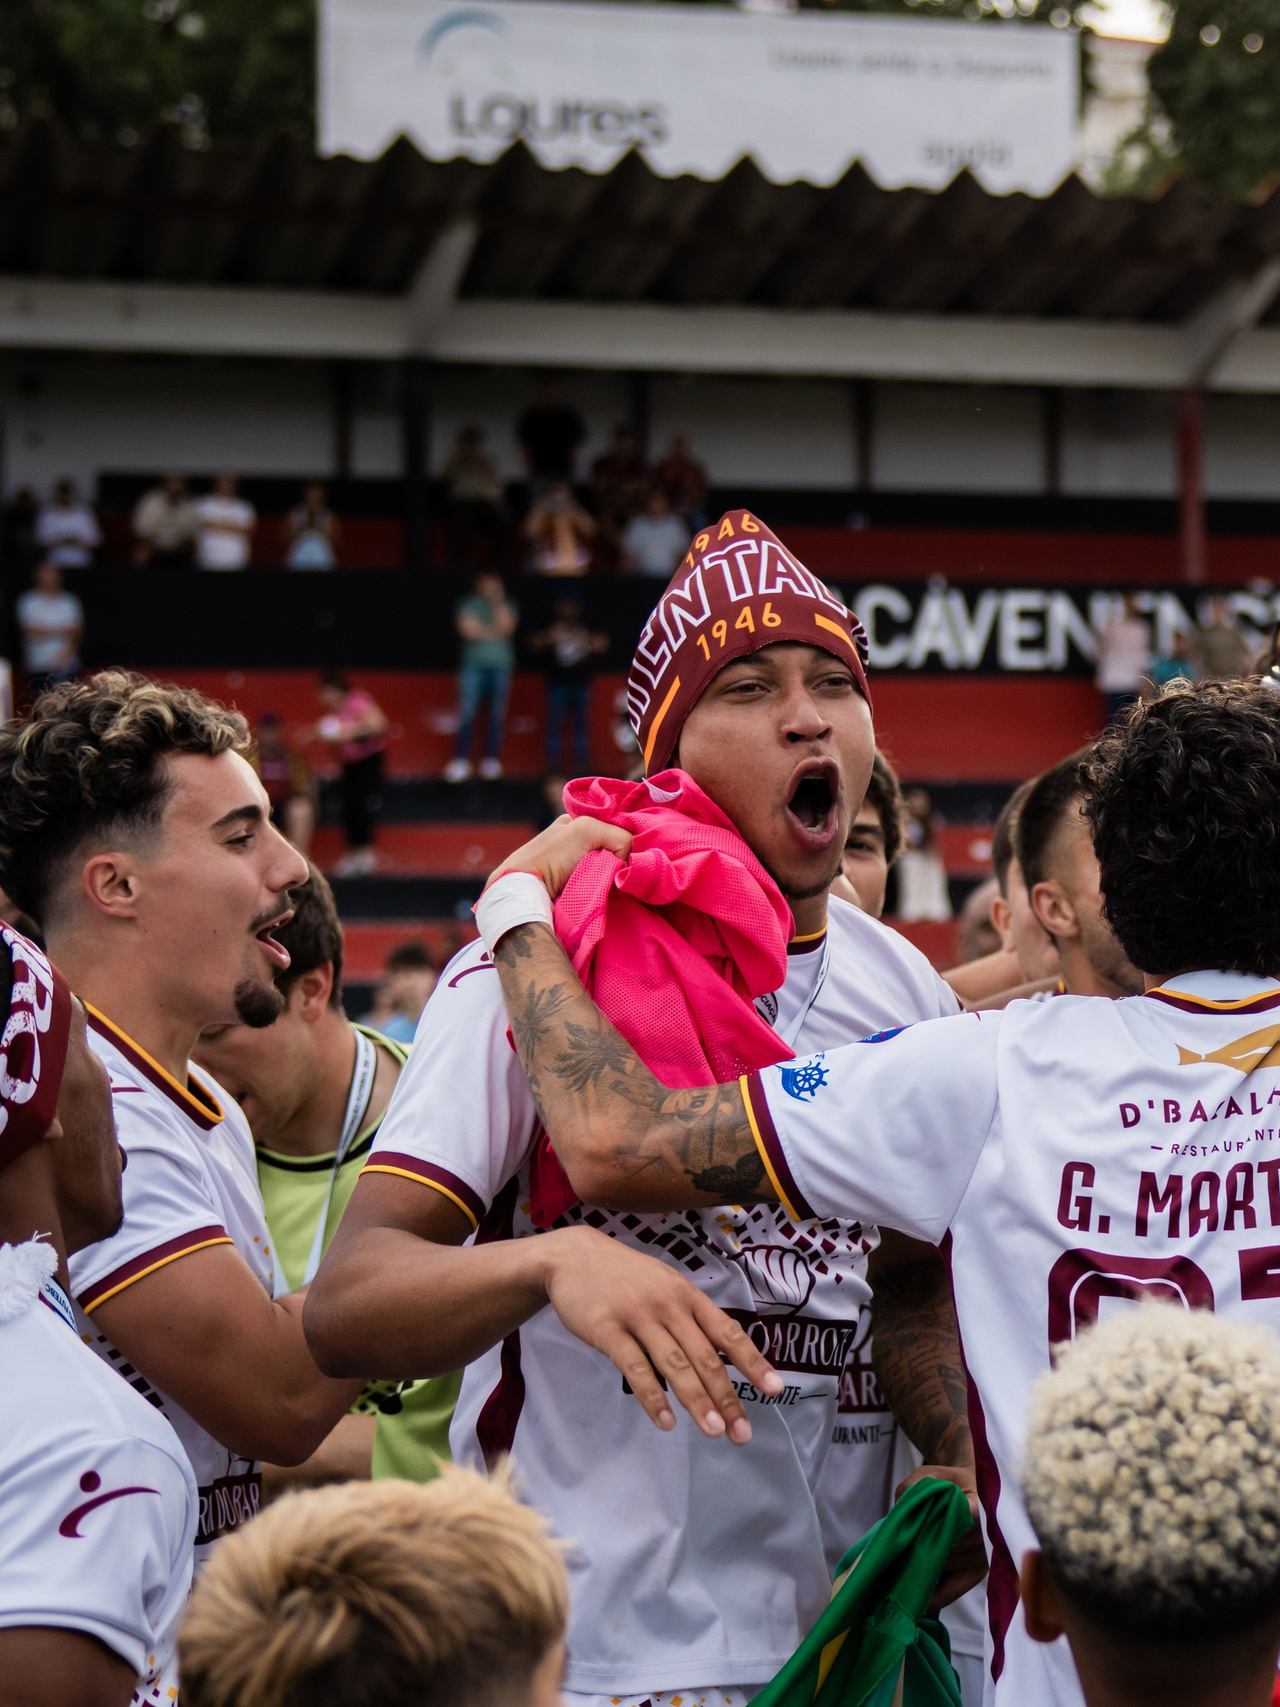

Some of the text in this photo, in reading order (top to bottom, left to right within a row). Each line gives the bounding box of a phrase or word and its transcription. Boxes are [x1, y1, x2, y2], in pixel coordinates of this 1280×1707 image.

[685, 513, 761, 569] 1946
[696, 602, 782, 661] 1946
[1056, 1161, 1111, 1234] G.
